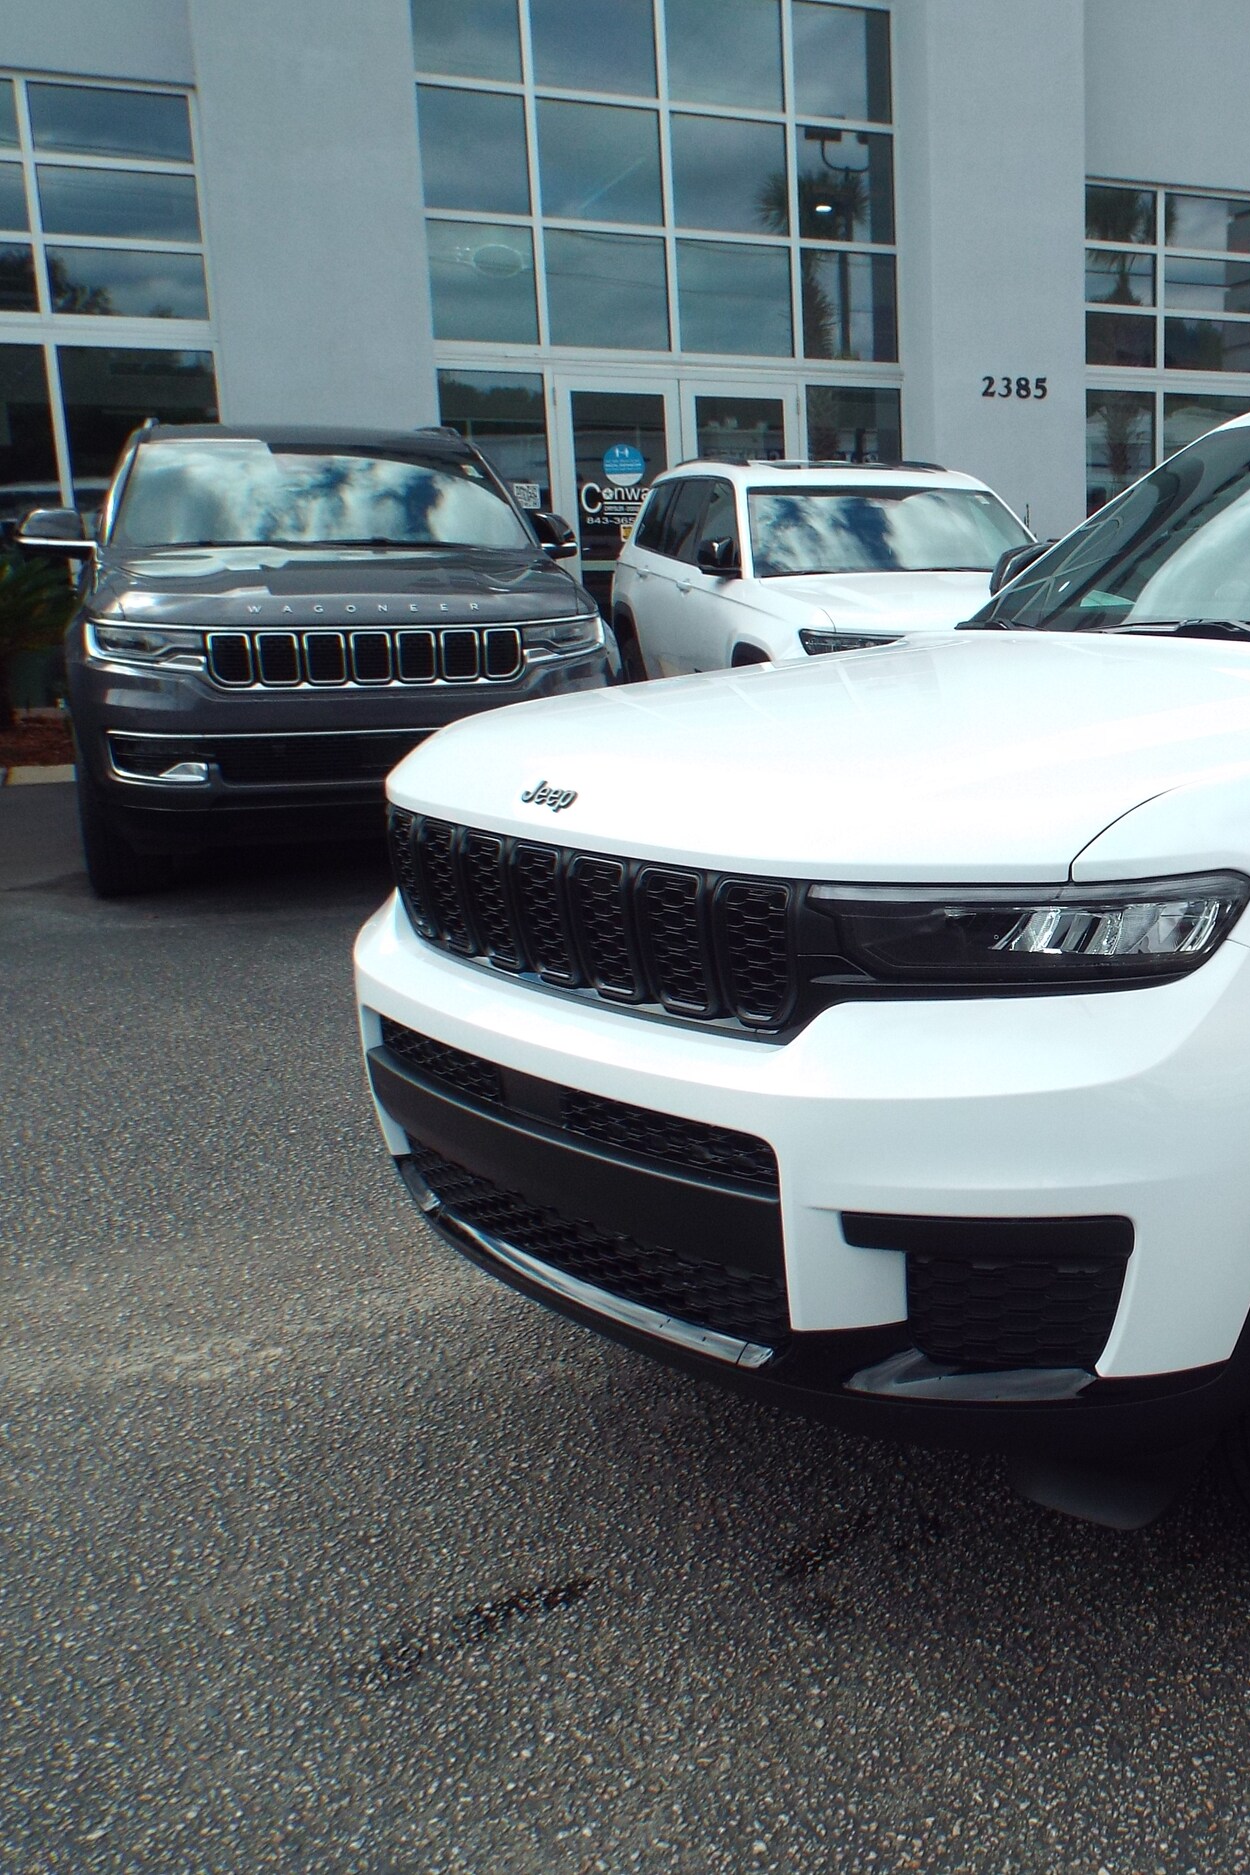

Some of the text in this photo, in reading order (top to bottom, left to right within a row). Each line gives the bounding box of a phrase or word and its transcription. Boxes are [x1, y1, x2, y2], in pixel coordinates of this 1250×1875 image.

[982, 376, 1048, 400] 2385
[247, 602, 480, 614] WAGONEER
[521, 780, 579, 813] Jeep
